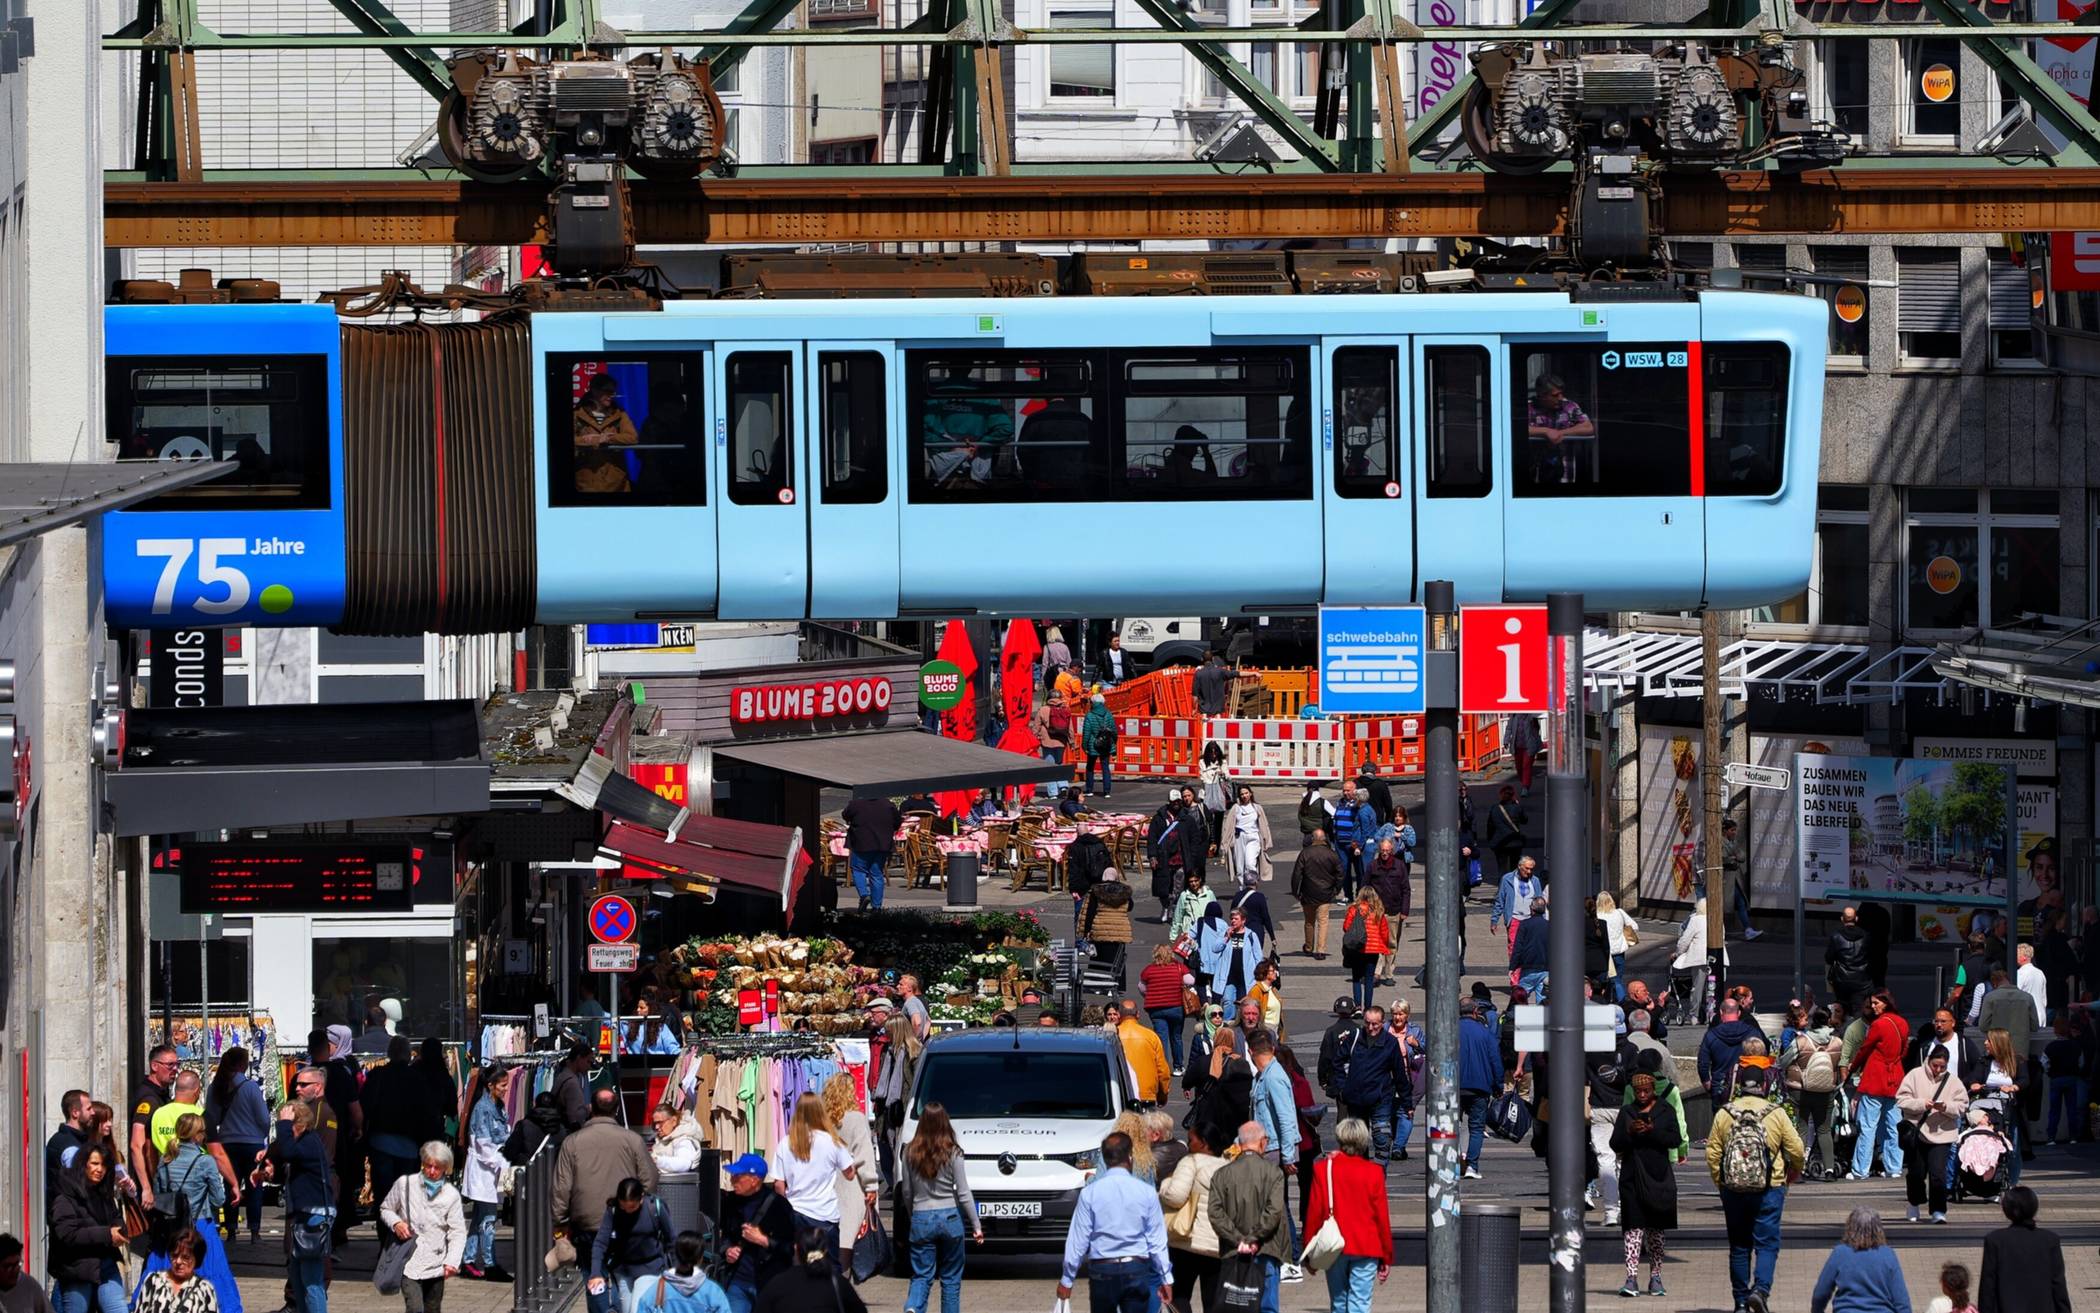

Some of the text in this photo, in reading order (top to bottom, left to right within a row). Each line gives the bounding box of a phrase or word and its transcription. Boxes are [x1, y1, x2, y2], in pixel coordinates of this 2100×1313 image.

[1627, 354, 1657, 365] WSW
[1669, 354, 1685, 365] 28
[136, 537, 305, 615] 75 Jahre
[1326, 631, 1418, 643] schwebebahn
[923, 674, 959, 684] BLUME
[926, 683, 957, 693] 2000
[739, 680, 891, 720] BLUME 2000
[1986, 748, 2047, 761] FREUNDE
[1803, 767, 1867, 782] ZUSAMMEN
[1804, 784, 1865, 798] BAUEN WIR
[1804, 799, 1858, 813] DAS NEUE
[2017, 806, 2037, 818] OU!
[1804, 815, 1861, 829] ELBERFELD
[592, 948, 633, 958] Rettungsweg
[595, 960, 633, 968] Feuerehr
[980, 1203, 1040, 1215] D PS 624E
